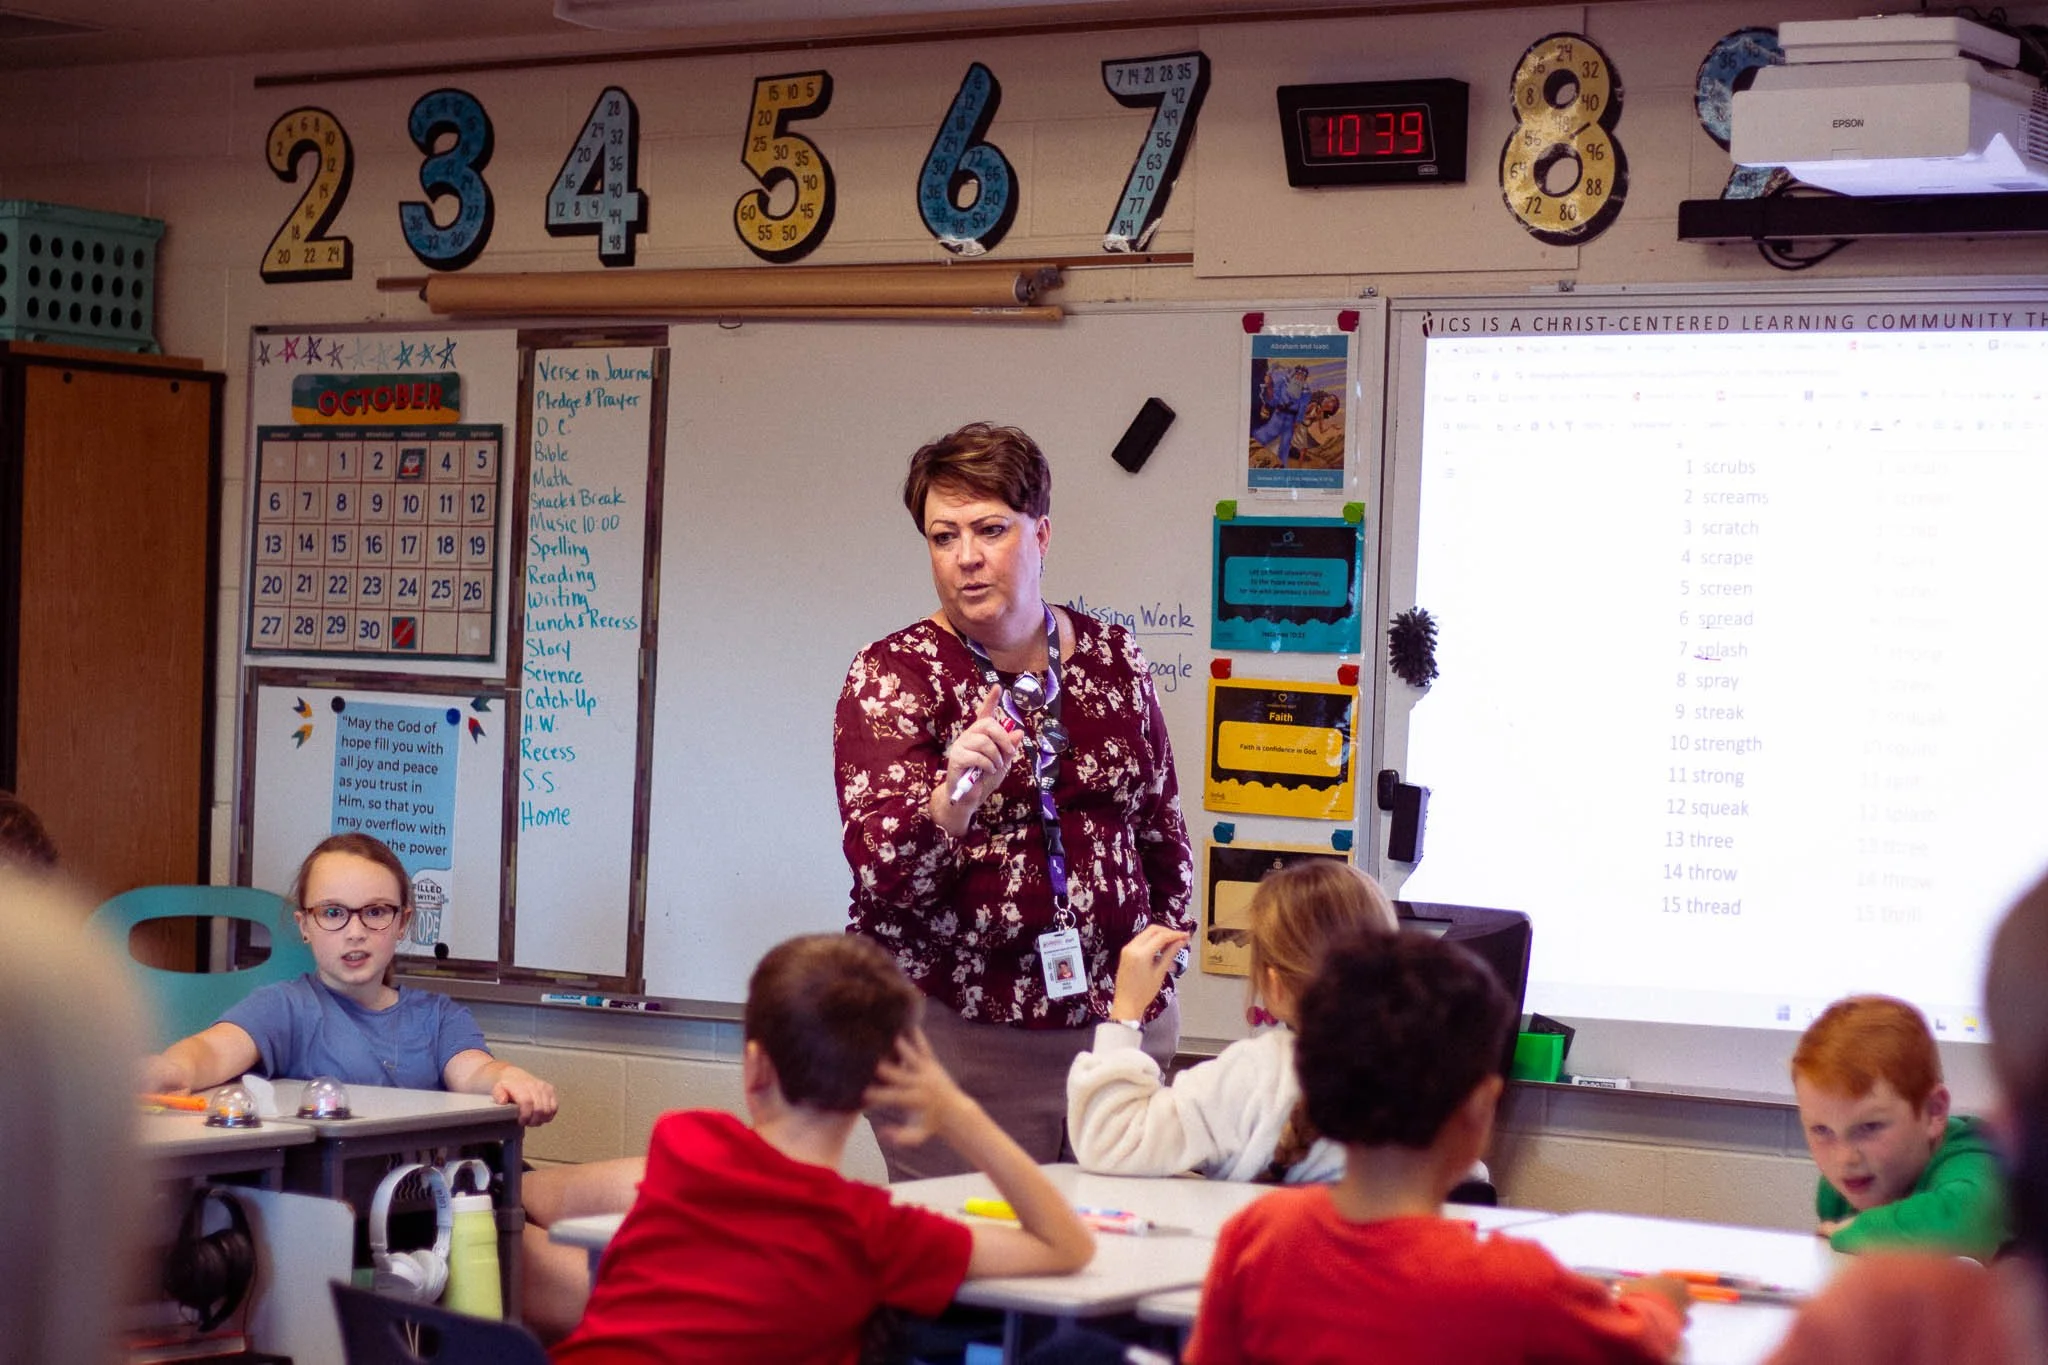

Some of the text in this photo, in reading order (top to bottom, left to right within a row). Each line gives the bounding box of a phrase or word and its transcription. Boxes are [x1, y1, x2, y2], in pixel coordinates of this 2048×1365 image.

[1117, 63, 1191, 86] 7 14 21 28 35
[1172, 88, 1184, 103] 42
[1164, 110, 1177, 125] 49
[1832, 119, 1863, 128] EPSON
[1157, 132, 1171, 148] 56
[1499, 32, 1628, 246] 8
[916, 61, 1019, 257] 6
[1101, 50, 1211, 252] 7
[733, 69, 836, 264] 5
[1147, 154, 1161, 170] 63
[399, 87, 495, 272] 3
[544, 85, 649, 267] 4
[1138, 176, 1153, 191] 70
[260, 105, 354, 284] 2
[1130, 197, 1144, 213] 77
[1120, 220, 1133, 236] 84
[1440, 317, 1471, 332] ICS
[1483, 316, 1499, 331] IS
[1511, 316, 1521, 331] A
[1534, 315, 1729, 332] CHRIST-CENTERED
[1743, 314, 1853, 330] LEARNING
[1867, 312, 2012, 329] COMMUNITY
[539, 356, 580, 381] Verse
[586, 363, 599, 380] in
[318, 382, 443, 416] OCTOBER
[537, 390, 581, 418] Pledge
[593, 387, 640, 410] Prayer
[340, 451, 487, 470] 1 2 4 5
[535, 441, 568, 462] Bible
[533, 465, 573, 488] Math
[1687, 459, 1756, 474] 1 scrubs
[270, 493, 485, 513] 6 7 8 9 10 11 12
[579, 487, 626, 507] Break
[1684, 489, 1769, 504] 2 screams
[531, 513, 577, 534] Music
[1684, 520, 1759, 535] 3 scratch
[266, 534, 485, 555] 13 14 15 16 17 18 19
[530, 535, 590, 567] Spelling
[1681, 549, 1754, 566] 4 scrape
[261, 575, 481, 600] 20 21 22 23 24 25 26
[528, 566, 596, 592] Reading
[1680, 580, 1753, 596] 5 screen
[527, 613, 576, 632] Lunch
[590, 609, 638, 630] Recess
[1141, 602, 1194, 628] Work
[1679, 611, 1754, 628] 6 spread
[261, 616, 379, 639] 27 28 29 30
[526, 638, 570, 662] Story
[1680, 641, 1748, 659] 7 splash
[524, 660, 583, 683] Science
[1148, 653, 1192, 692] oogle
[1676, 672, 1739, 691] 8 spray
[1269, 713, 1293, 722] Faith
[1675, 703, 1744, 720] 9 streak
[375, 719, 393, 731] the
[397, 720, 421, 734] God
[424, 722, 437, 734] of
[341, 736, 443, 755] hope fill you with
[522, 738, 576, 762] Recess
[1262, 745, 1295, 753] confidence
[1670, 734, 1762, 755] 10 strength
[340, 756, 438, 775] all joy and peace
[339, 777, 422, 794] as you trust in
[1668, 767, 1745, 788] 11 strong
[368, 799, 381, 810] so
[385, 799, 408, 813] that
[412, 803, 434, 816] you
[522, 800, 570, 832] Home
[1667, 798, 1749, 818] 12 squeak
[337, 815, 446, 836] may overflow with
[386, 839, 447, 856] the power
[1665, 830, 1734, 848] 13 three
[1664, 863, 1737, 881] 14 throw
[1661, 896, 1742, 916] 15 thread
